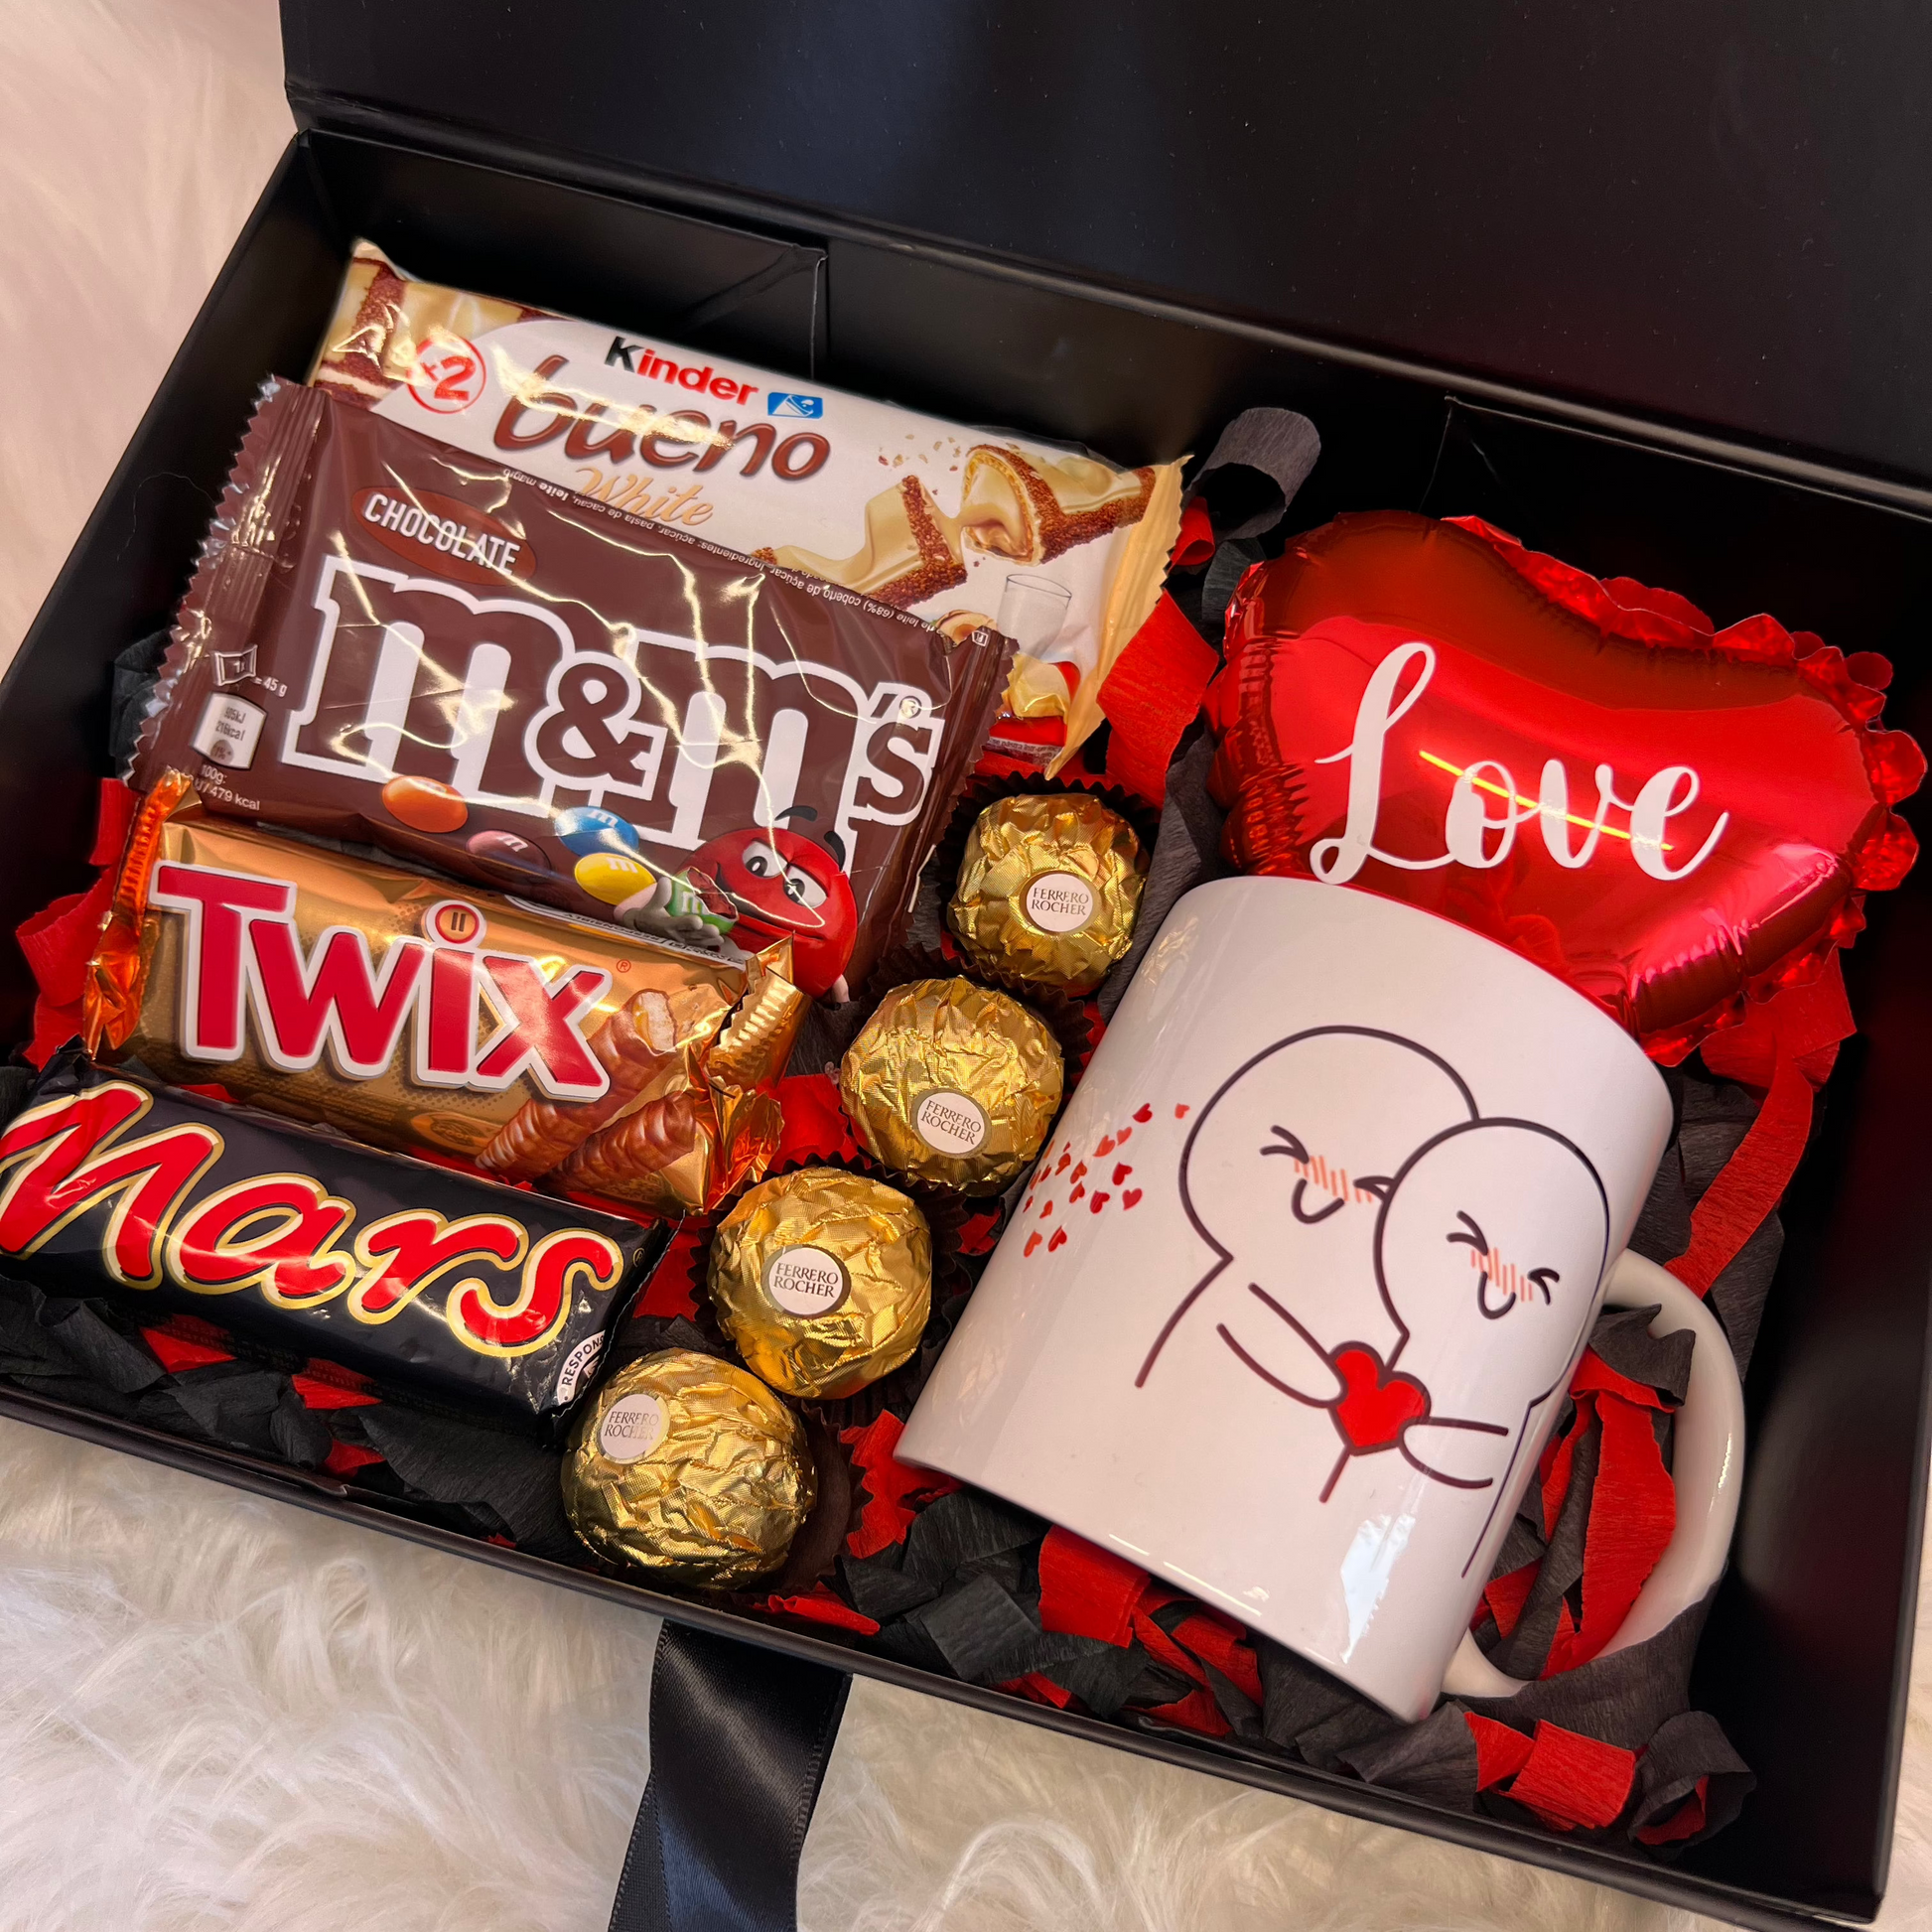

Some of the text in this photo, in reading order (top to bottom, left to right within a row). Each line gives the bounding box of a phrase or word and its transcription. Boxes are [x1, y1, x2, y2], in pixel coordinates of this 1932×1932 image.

[605, 336, 759, 407] Kinder
[493, 354, 832, 483] bueno
[538, 482, 568, 502] leite
[575, 466, 714, 527] White
[607, 508, 622, 519] de
[623, 513, 655, 530] pasta
[363, 491, 520, 576] CHOCOLATE
[1310, 642, 1730, 885] Love
[209, 785, 233, 802] 479
[234, 792, 261, 811] kcal
[1031, 898, 1087, 916] ROCHER
[1033, 887, 1090, 904] FERRERO
[919, 1110, 976, 1146] ROCHER
[925, 1099, 982, 1133] FERRERO
[0, 1079, 623, 1359] Mars
[775, 1262, 839, 1286] FERRERO
[772, 1275, 836, 1300] ROCHER
[608, 1410, 660, 1427] FERRERO
[604, 1423, 655, 1441] ROCHER
